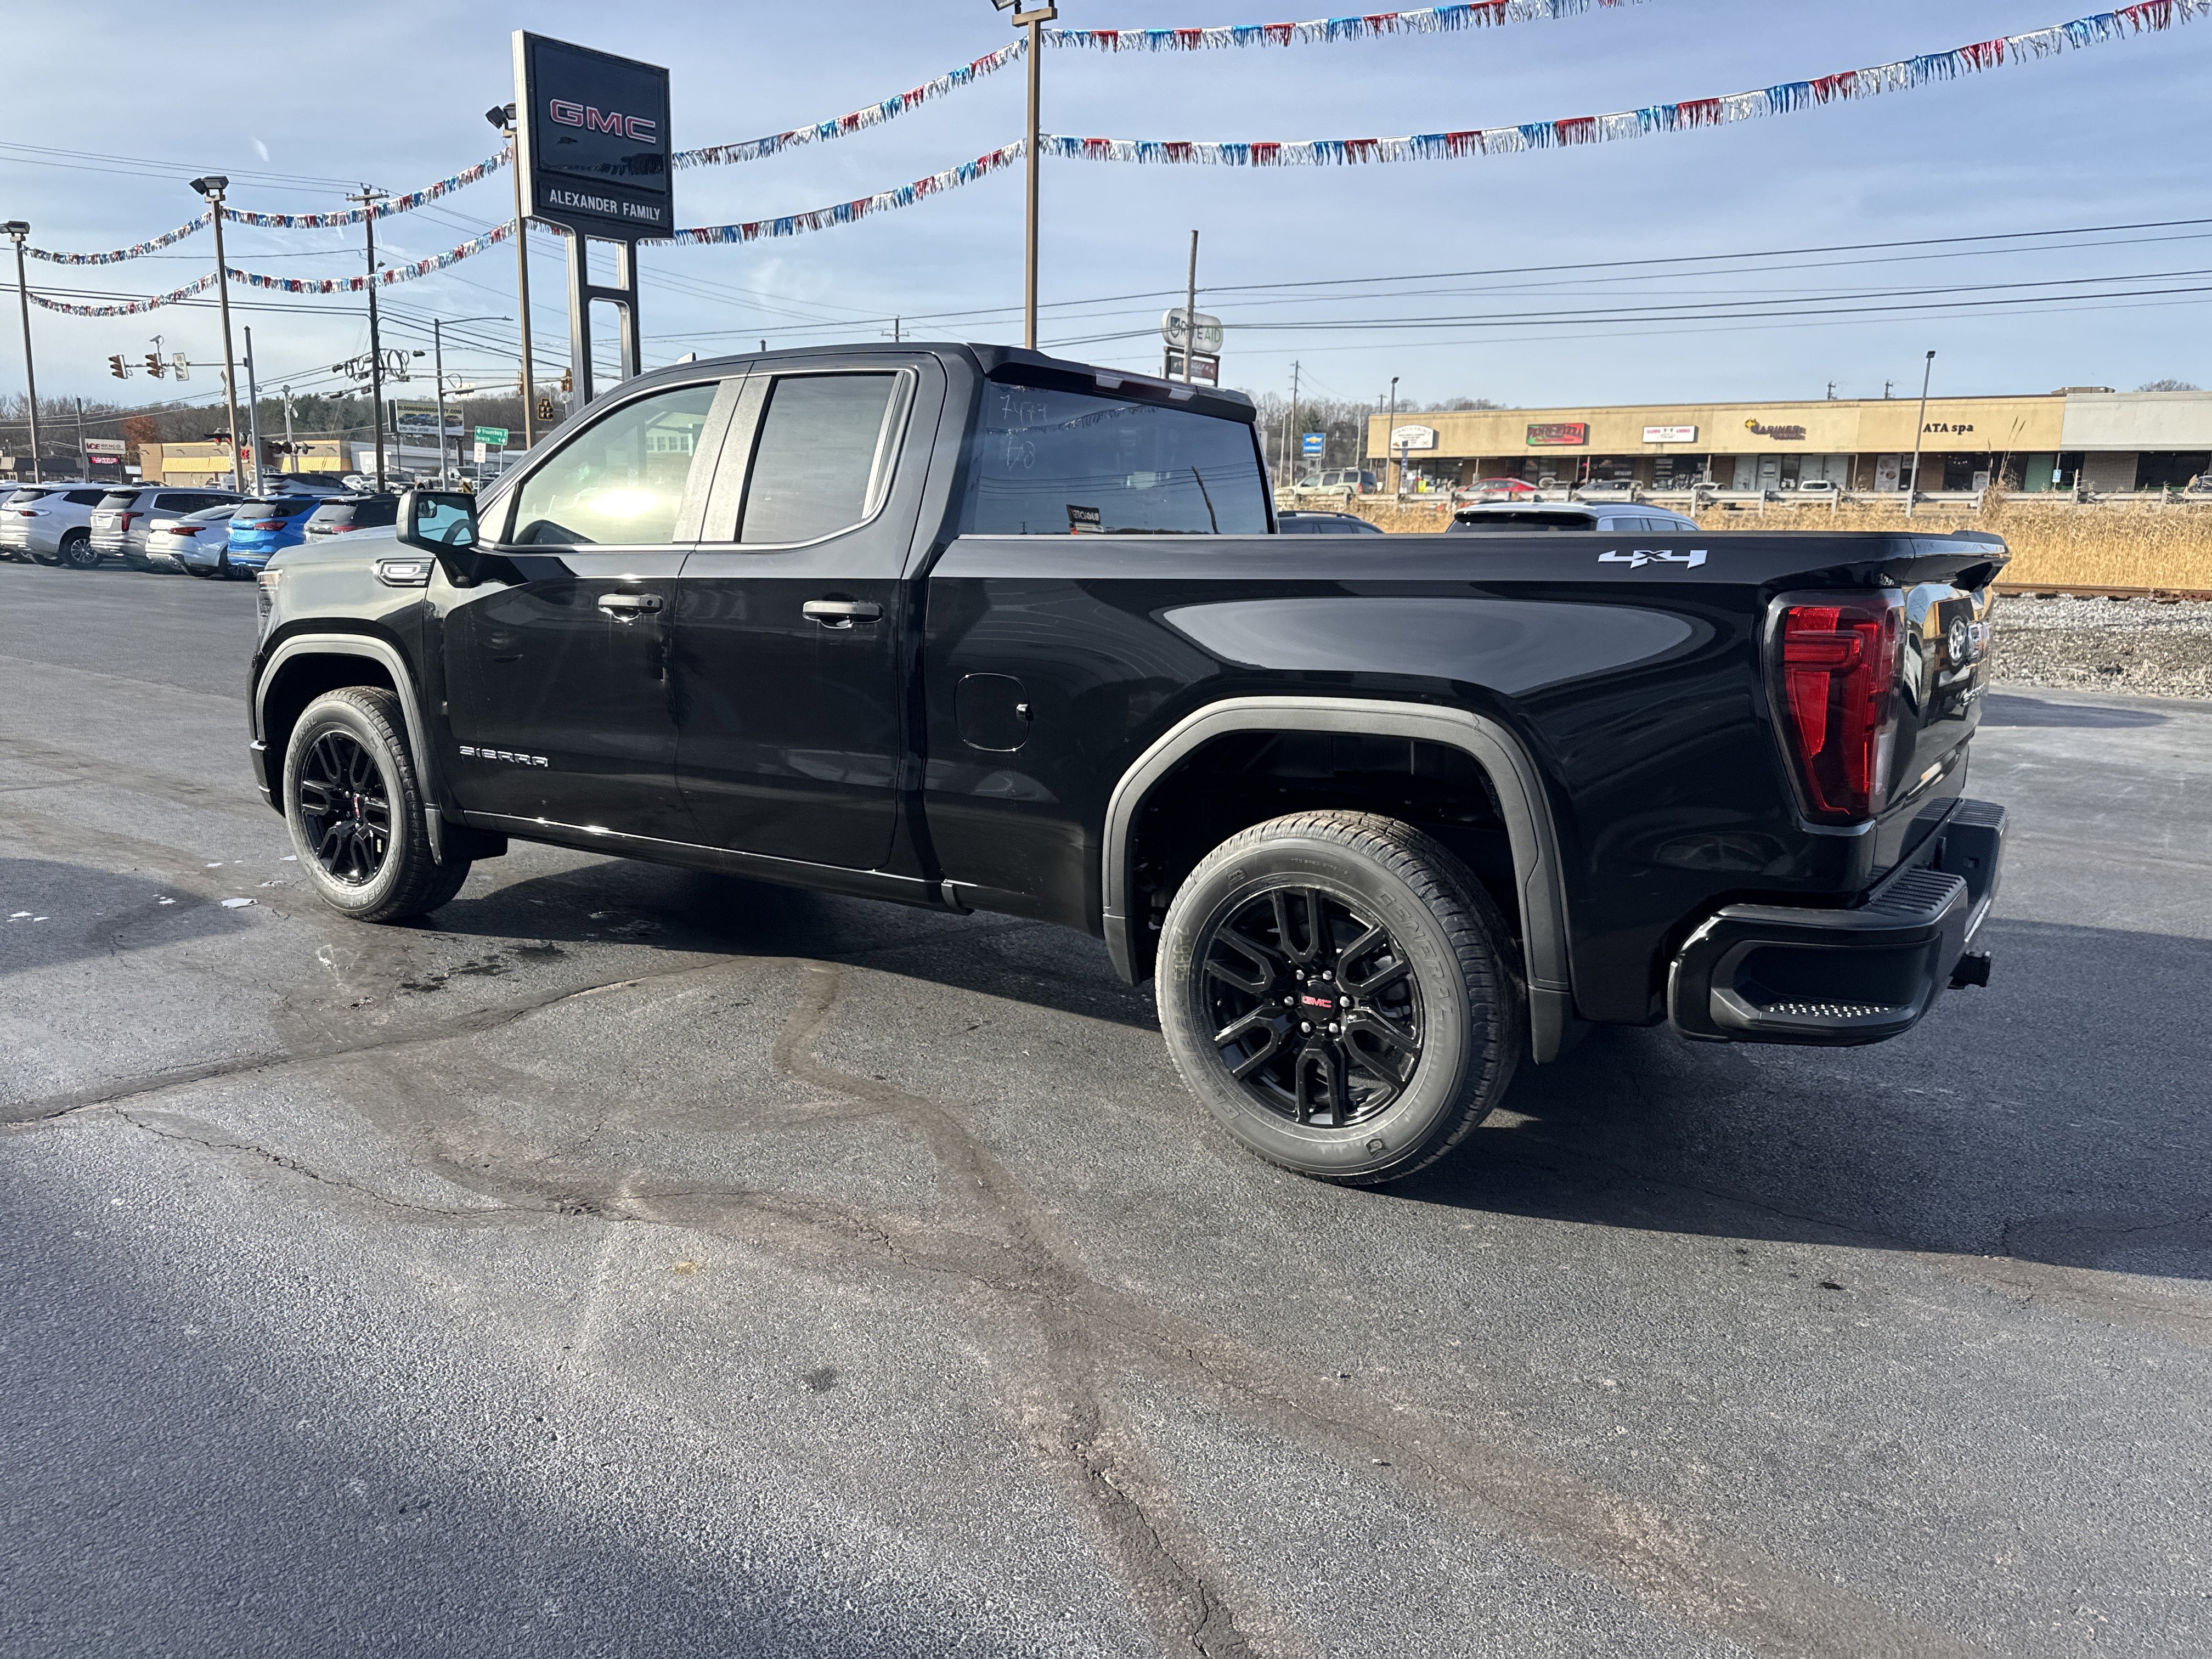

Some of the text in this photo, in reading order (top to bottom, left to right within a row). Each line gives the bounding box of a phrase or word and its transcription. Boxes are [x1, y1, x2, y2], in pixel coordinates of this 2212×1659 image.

[550, 98, 656, 144] GMC
[550, 189, 661, 222] ALEXANDER FAMILY
[1181, 320, 1221, 343] RE AID
[397, 406, 462, 414] BLOOMSBURGCHY.COM
[1922, 422, 1974, 436] ATA spa
[459, 746, 549, 768] SIERRA
[1378, 888, 1453, 1022] GENERAL
[1302, 995, 1332, 1008] GMC
